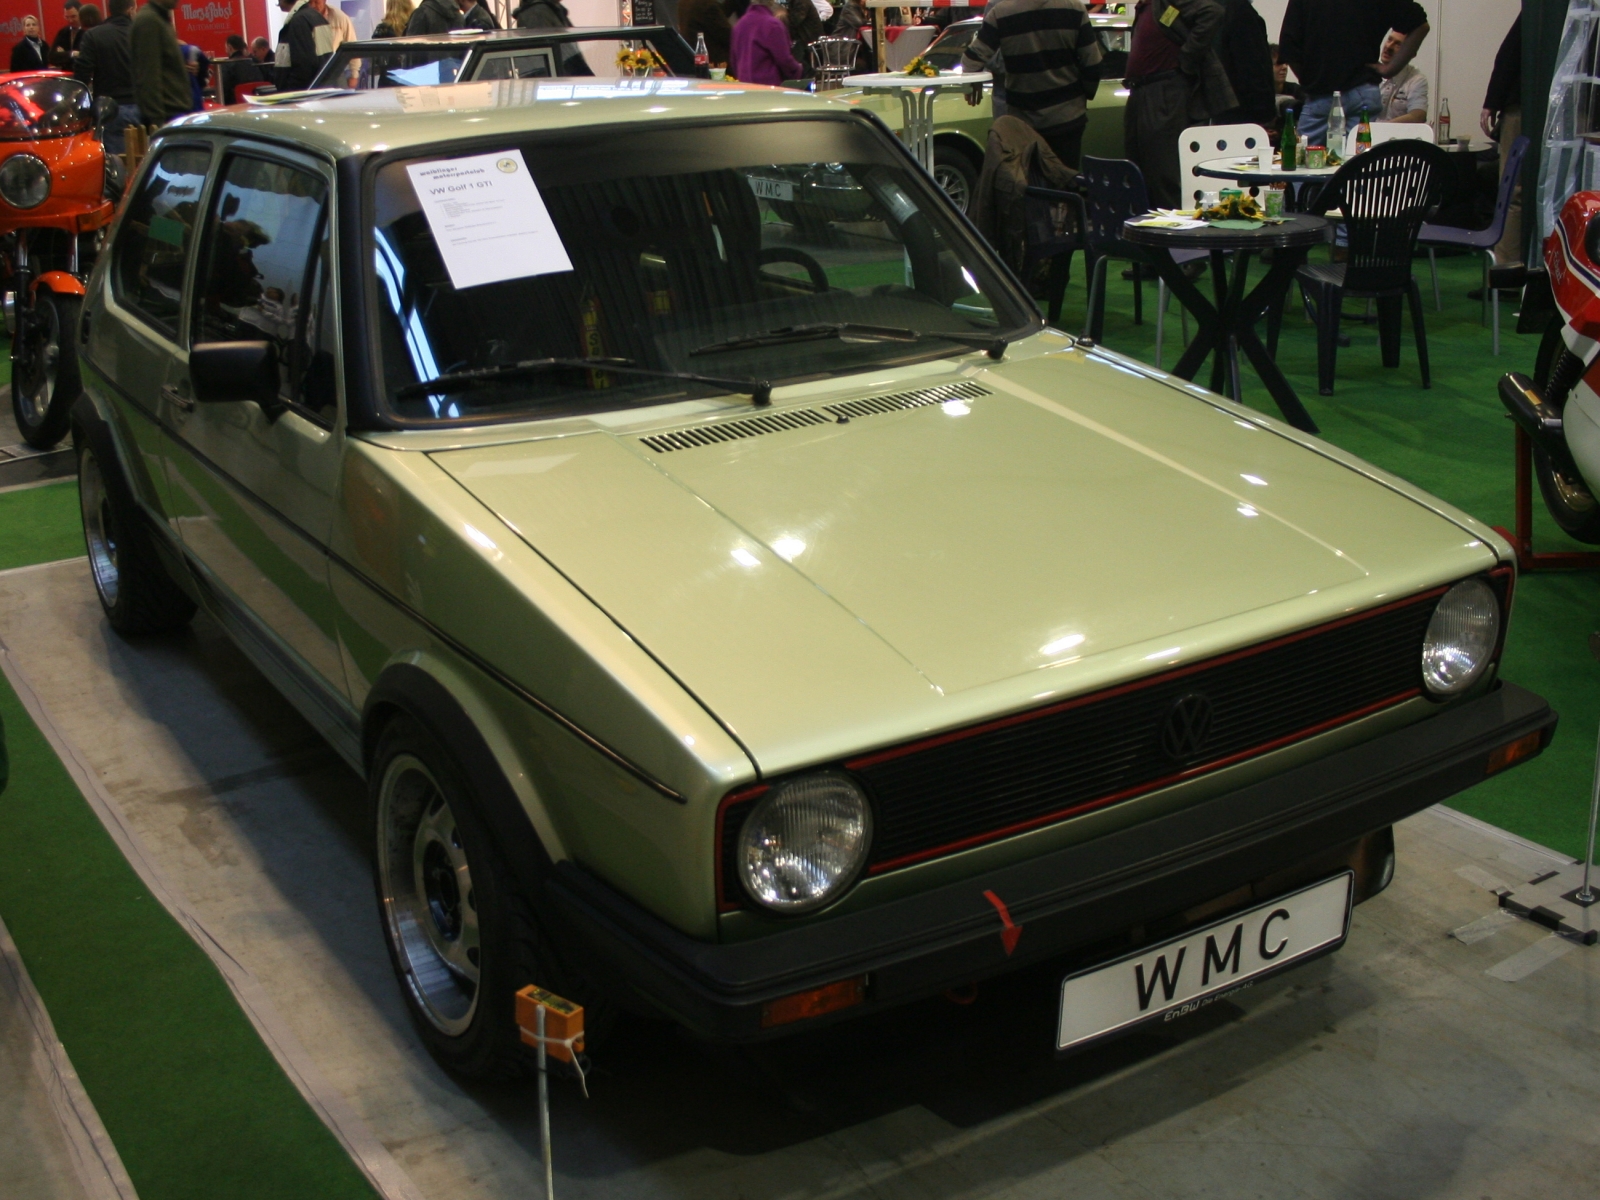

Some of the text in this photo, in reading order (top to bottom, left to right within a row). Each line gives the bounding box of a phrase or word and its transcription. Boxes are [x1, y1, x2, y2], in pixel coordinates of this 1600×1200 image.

[430, 186, 446, 196] VW
[447, 183, 467, 193] Golf
[476, 180, 493, 189] GTI
[756, 181, 782, 197] WMC
[1134, 908, 1290, 1012] WMC
[1163, 1000, 1200, 1022] EnBW
